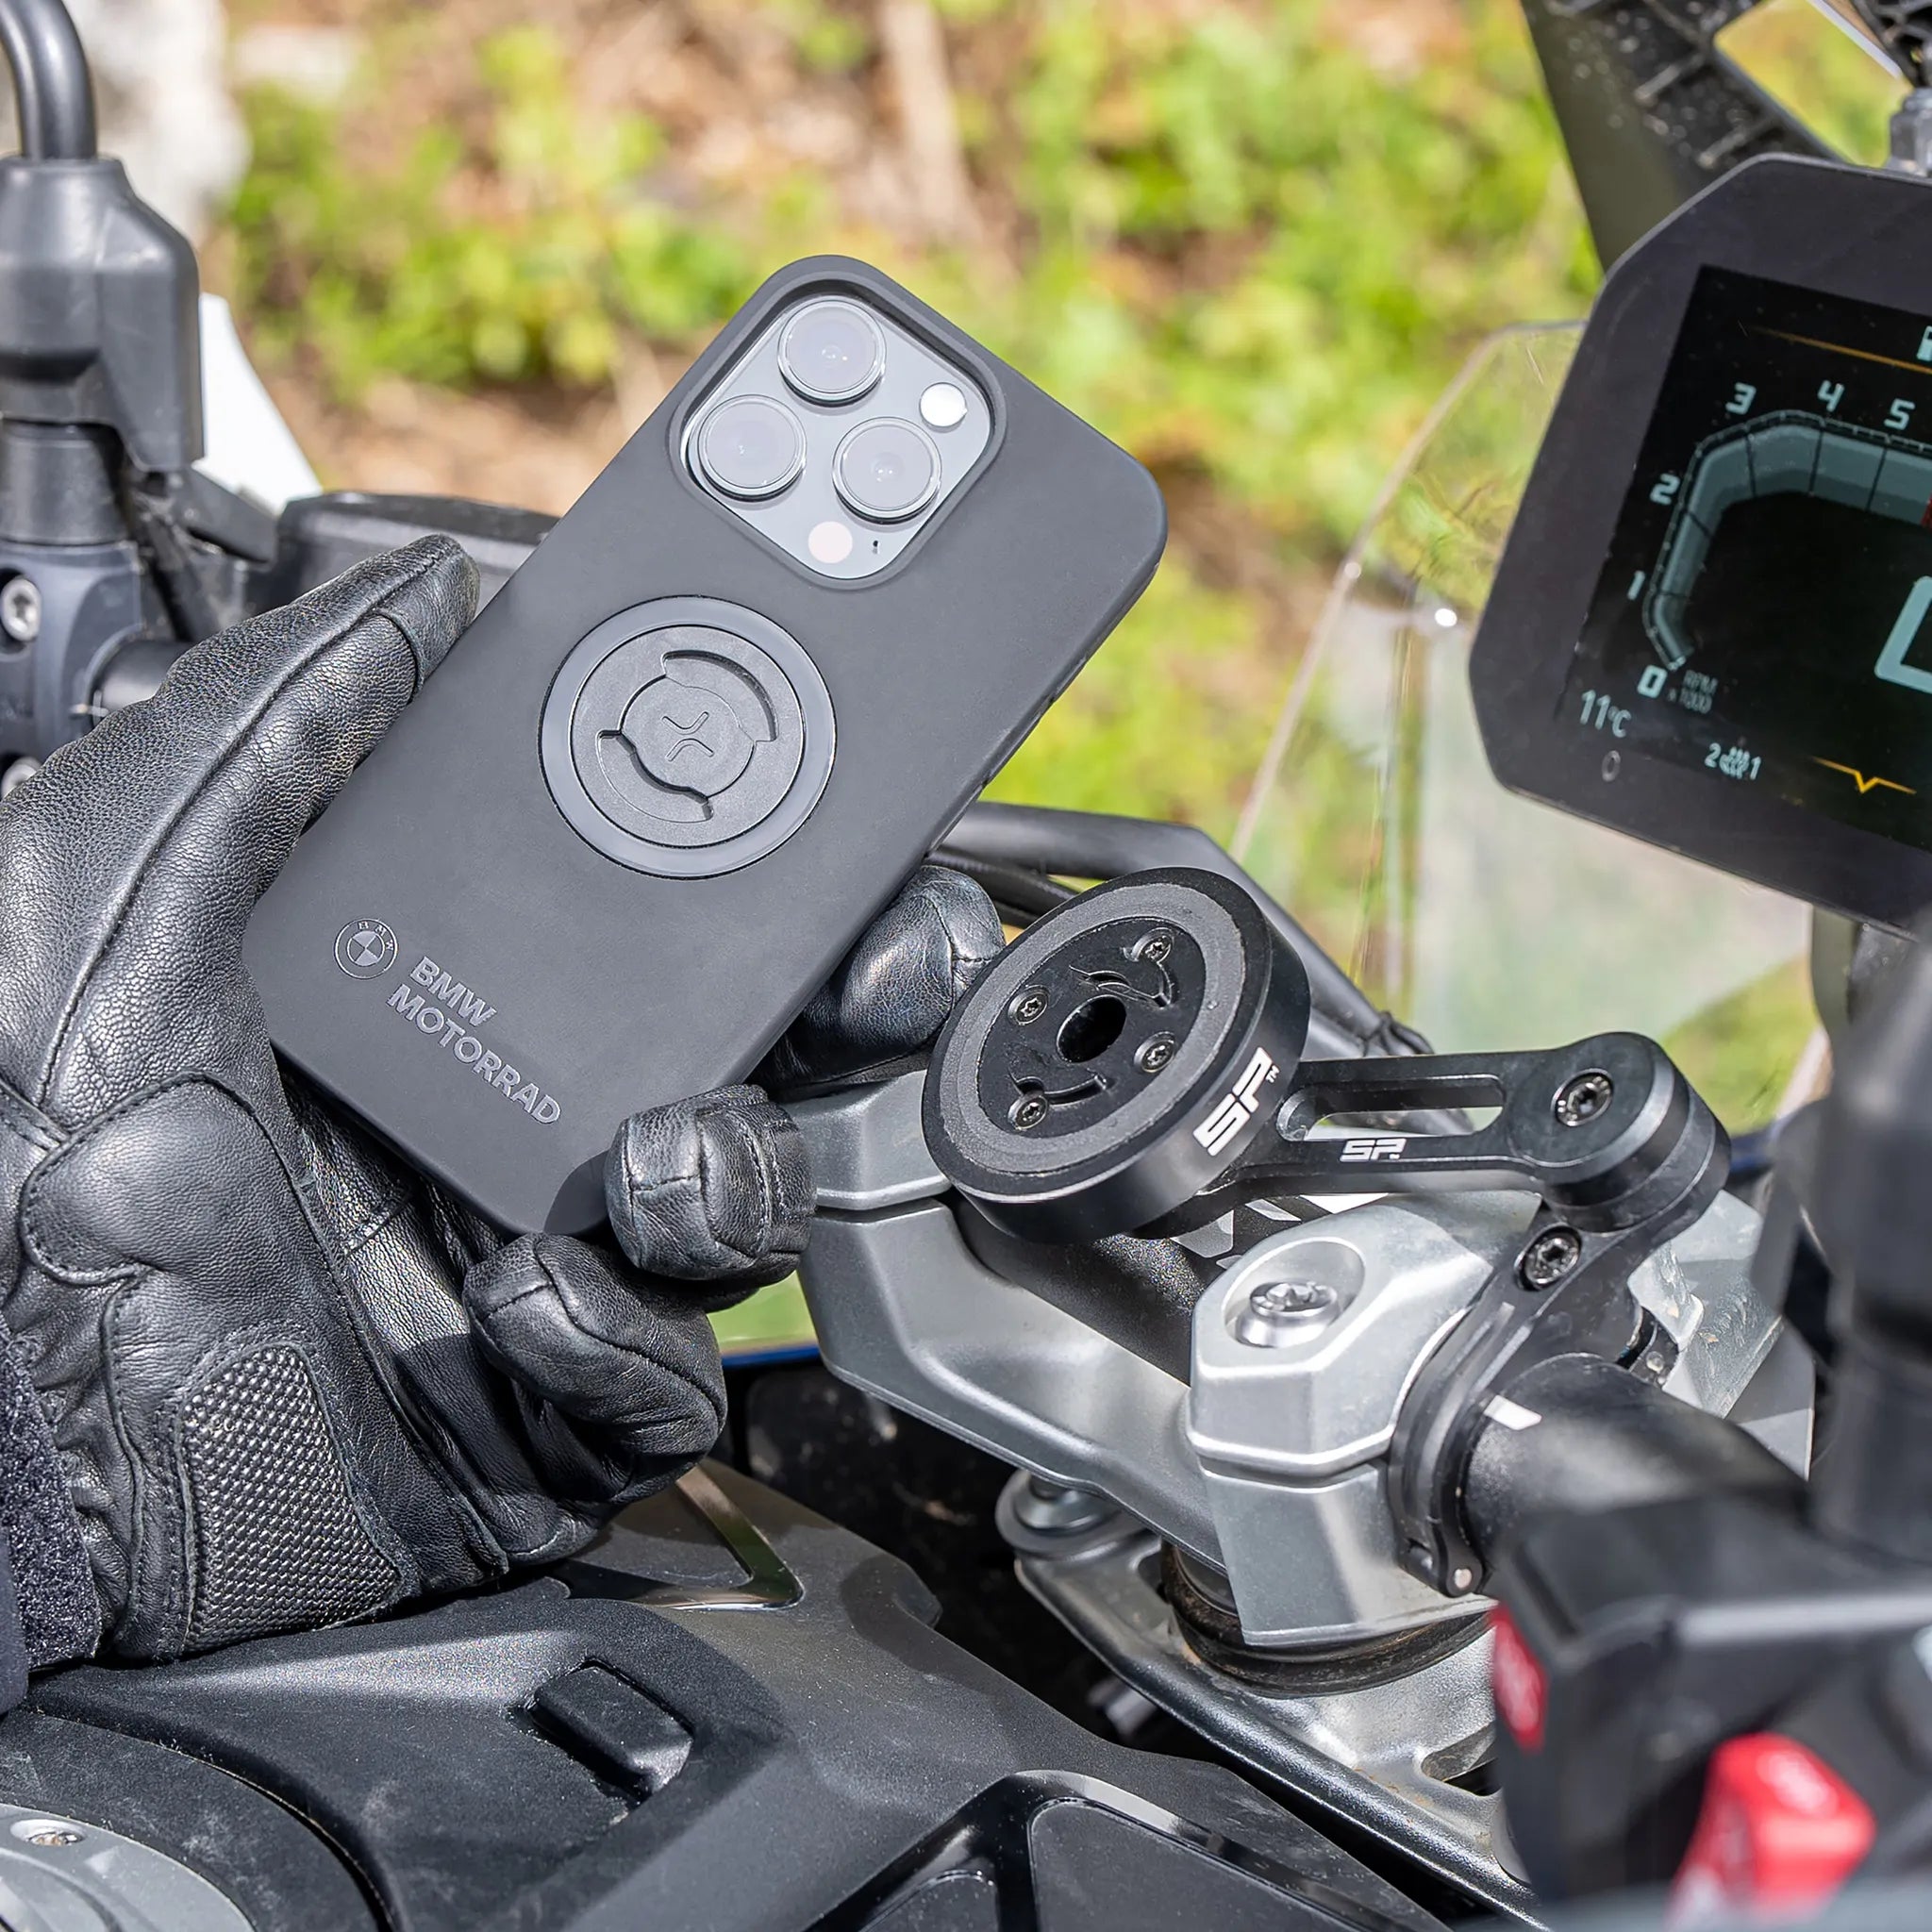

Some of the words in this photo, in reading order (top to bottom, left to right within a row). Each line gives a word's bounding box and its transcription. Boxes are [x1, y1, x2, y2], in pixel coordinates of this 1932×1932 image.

[1725, 382, 1757, 415] 3
[1817, 380, 1844, 411] 4
[1884, 398, 1915, 430] 5
[1650, 474, 1680, 505] 2
[1627, 570, 1645, 600] 1
[1637, 664, 1668, 698] 0
[409, 956, 497, 1027] BMW
[386, 983, 561, 1124] MOTORRAD
